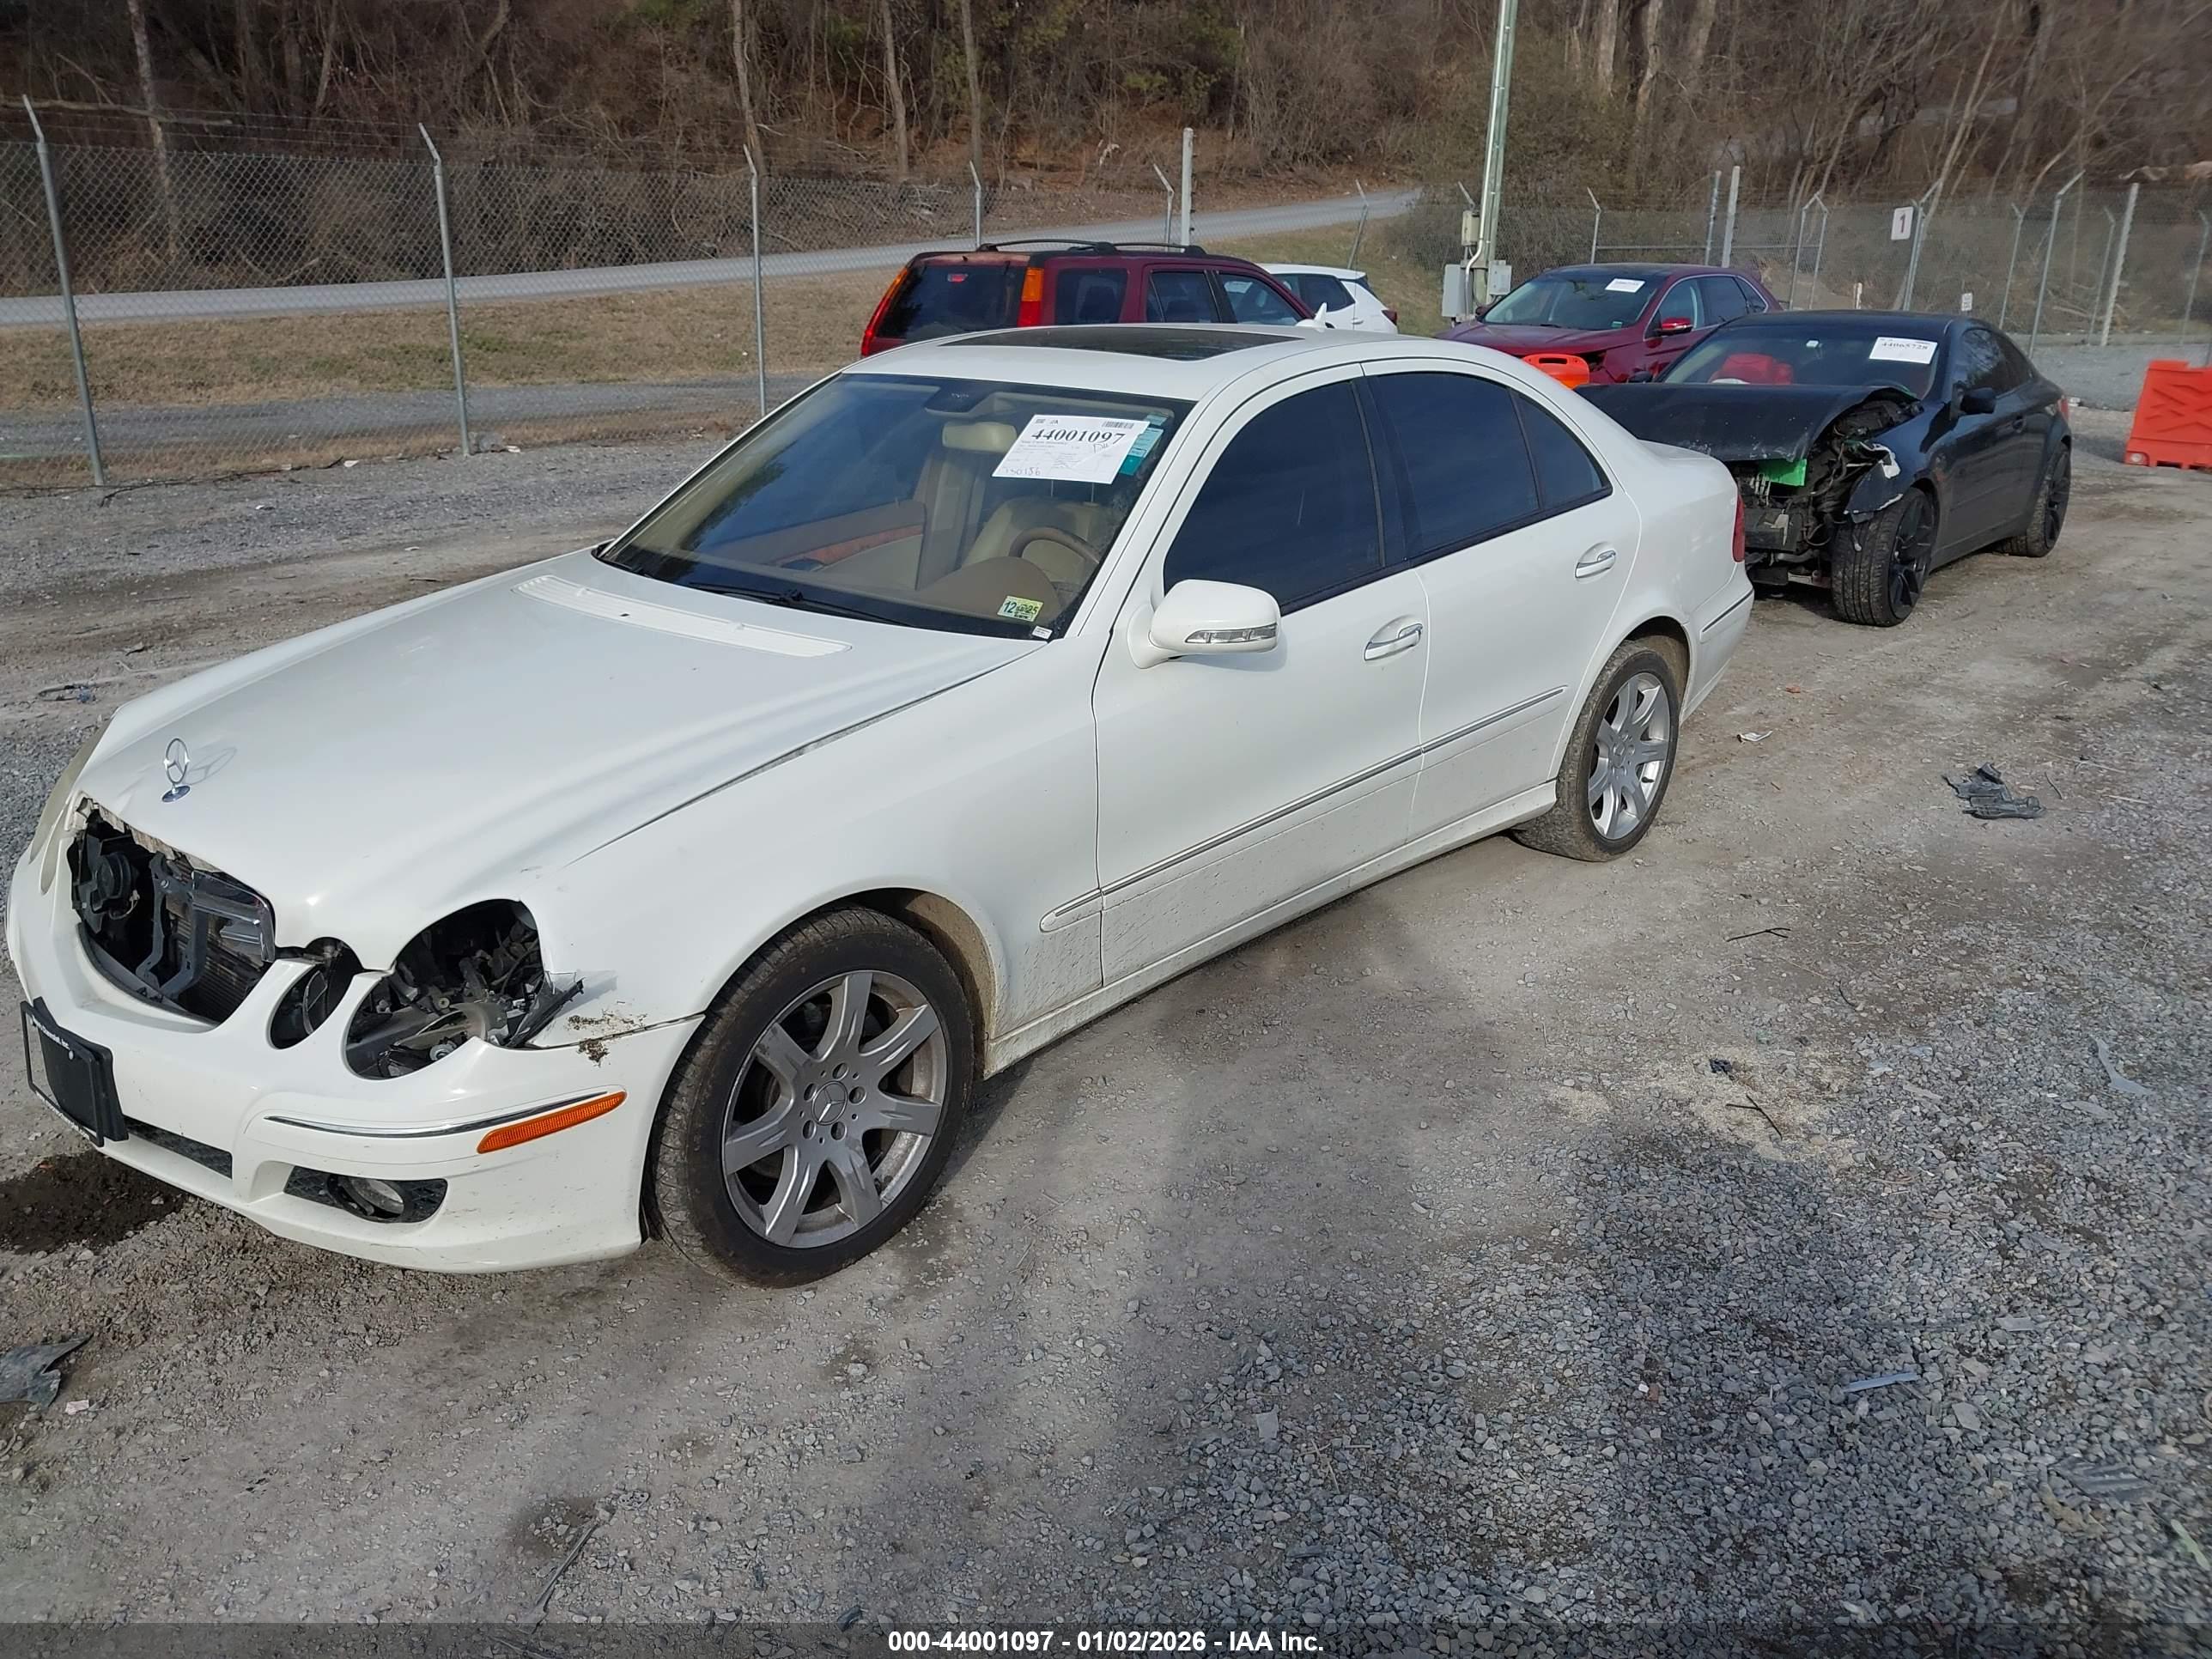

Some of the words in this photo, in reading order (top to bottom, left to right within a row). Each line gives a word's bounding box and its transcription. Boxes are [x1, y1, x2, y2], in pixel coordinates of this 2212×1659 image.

[1899, 213, 1906, 234] 1
[1031, 428, 1126, 445] 44001097
[1003, 601, 1018, 614] 12
[1026, 605, 1039, 615] 25
